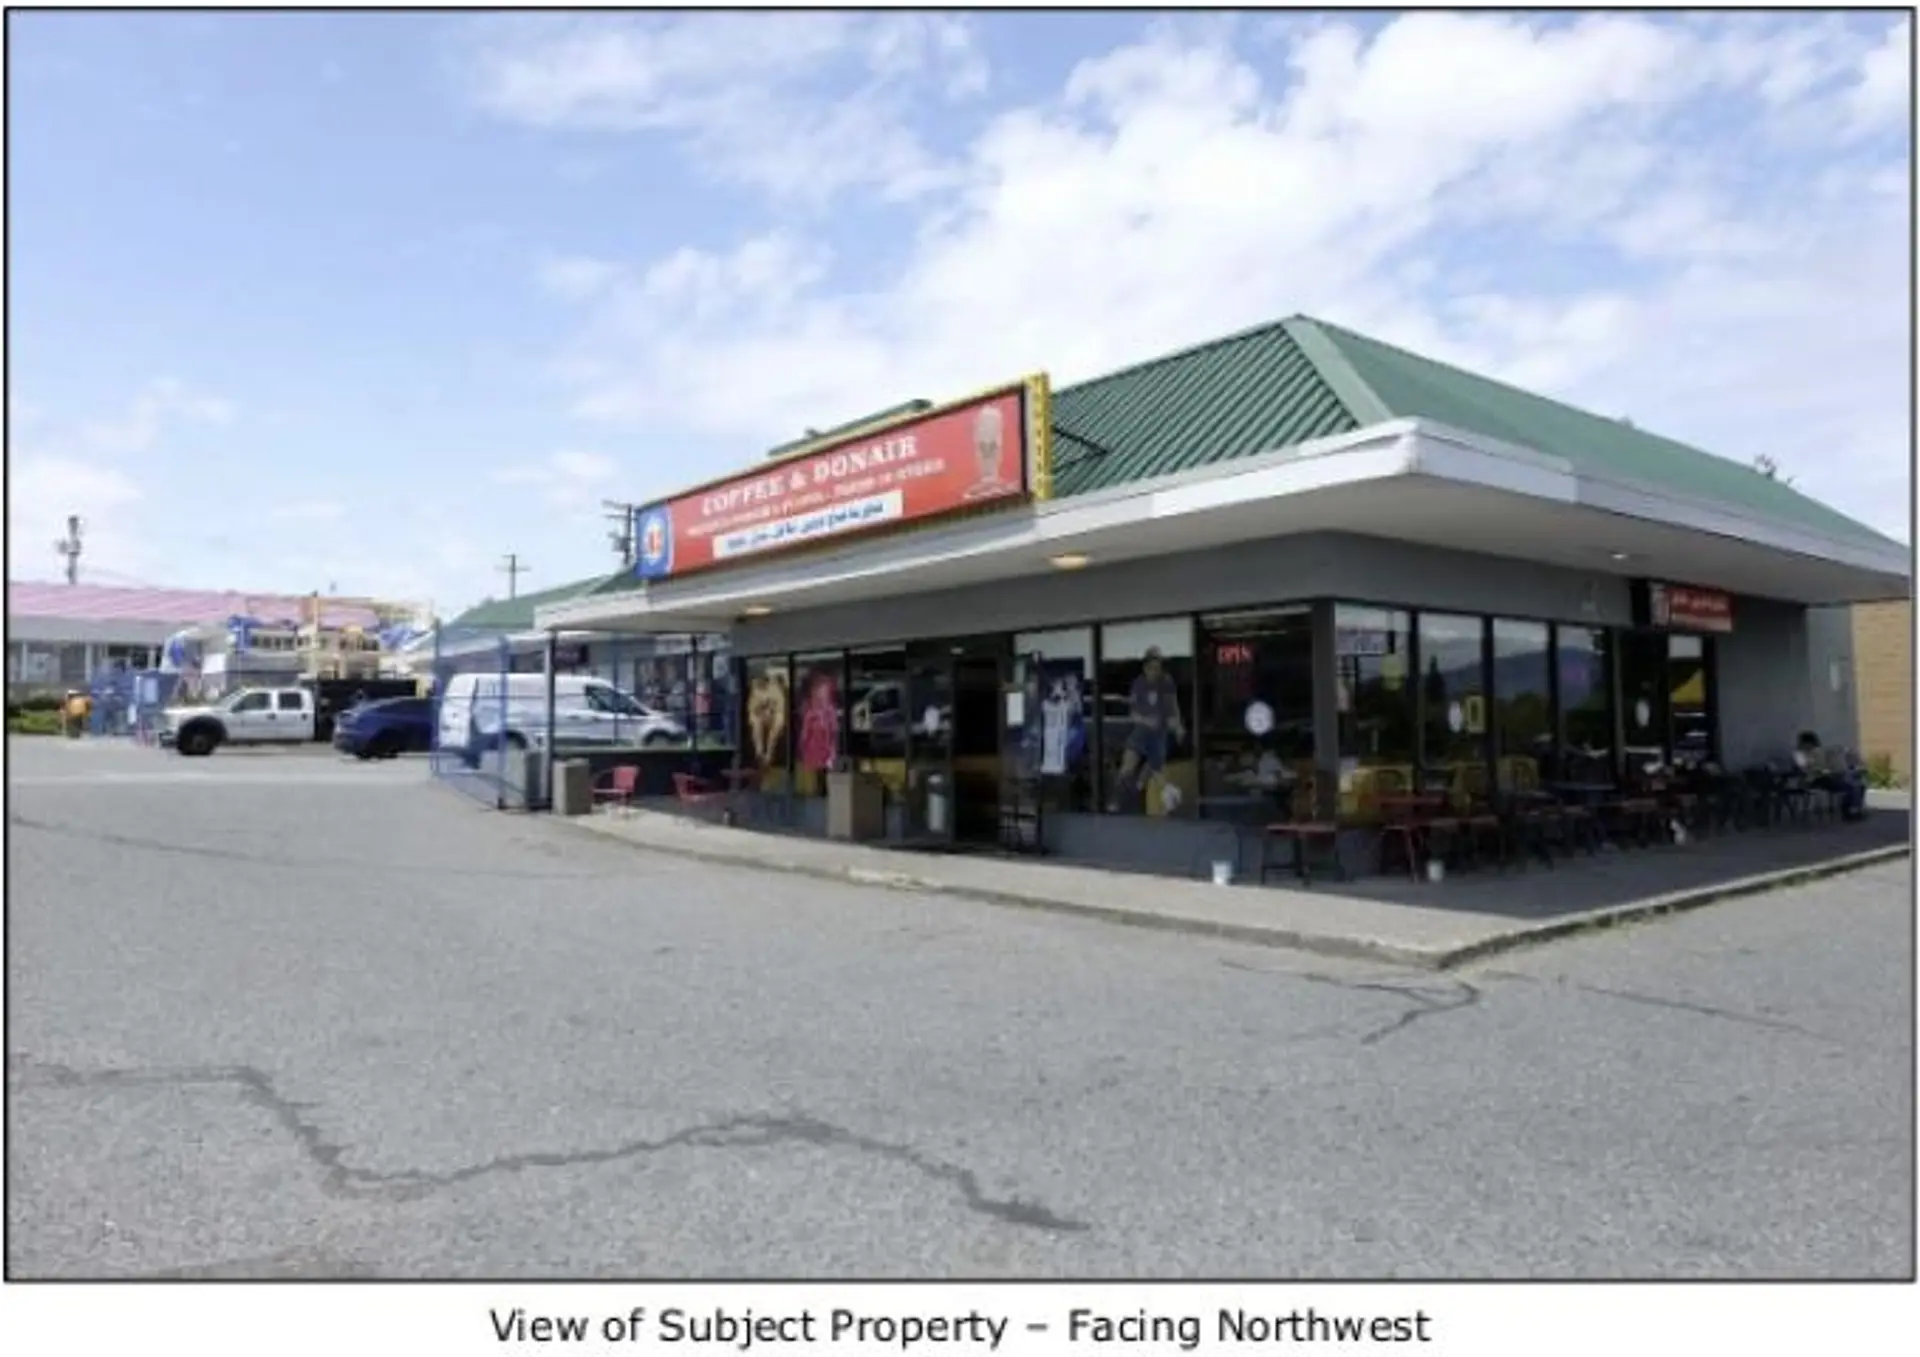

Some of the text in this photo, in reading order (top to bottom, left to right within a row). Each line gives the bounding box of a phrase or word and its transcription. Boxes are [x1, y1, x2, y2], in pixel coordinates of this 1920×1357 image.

[702, 475, 785, 515] COFFEE
[790, 467, 807, 492] &
[813, 435, 918, 484] DONAIR
